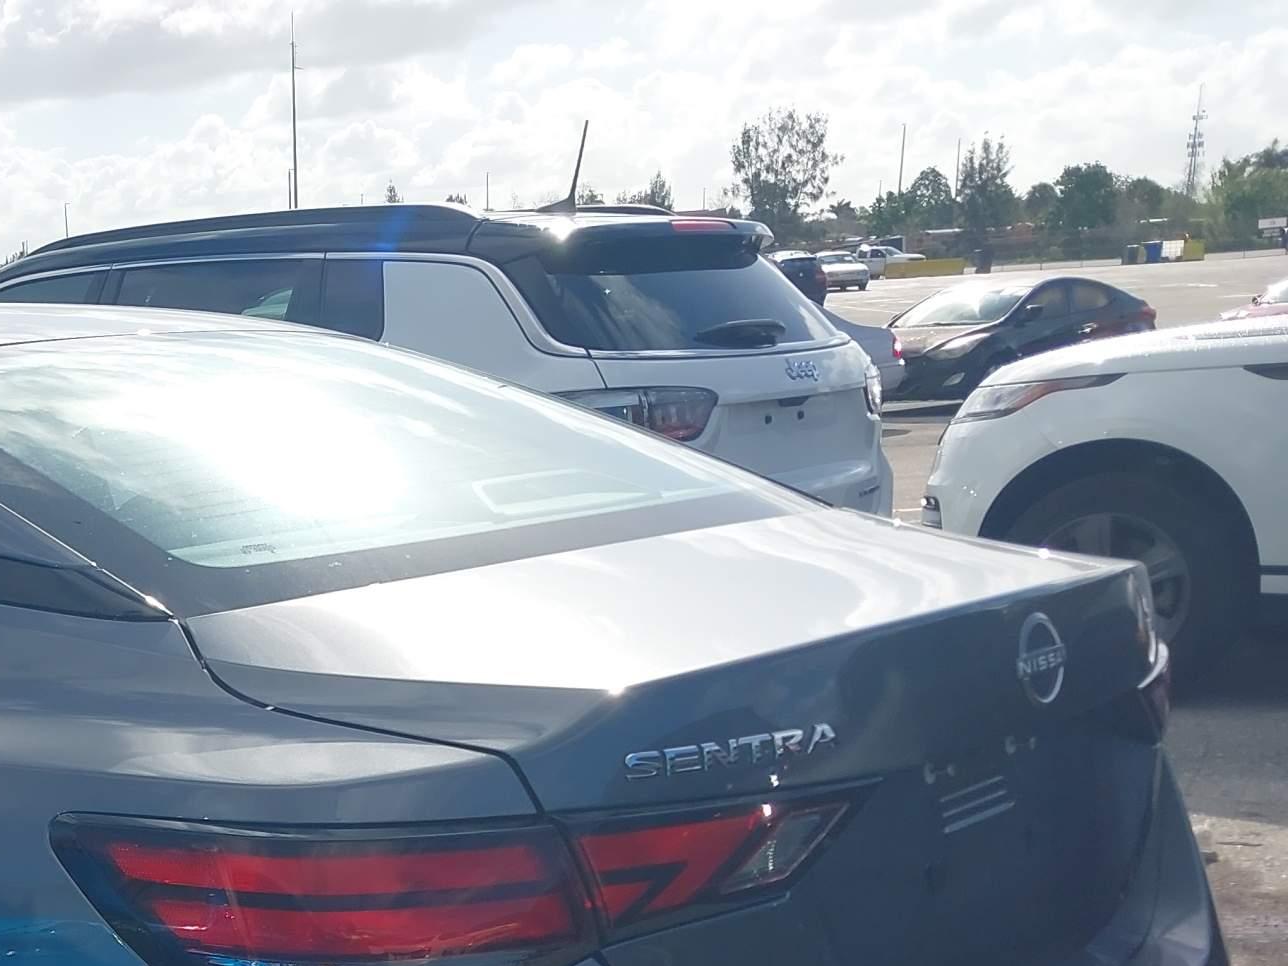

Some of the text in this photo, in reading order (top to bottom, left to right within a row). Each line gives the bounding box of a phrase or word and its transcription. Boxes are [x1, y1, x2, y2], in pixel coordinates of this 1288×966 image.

[785, 358, 819, 382] Jeep
[1016, 650, 1065, 677] NISS
[624, 722, 837, 782] SENTRA
